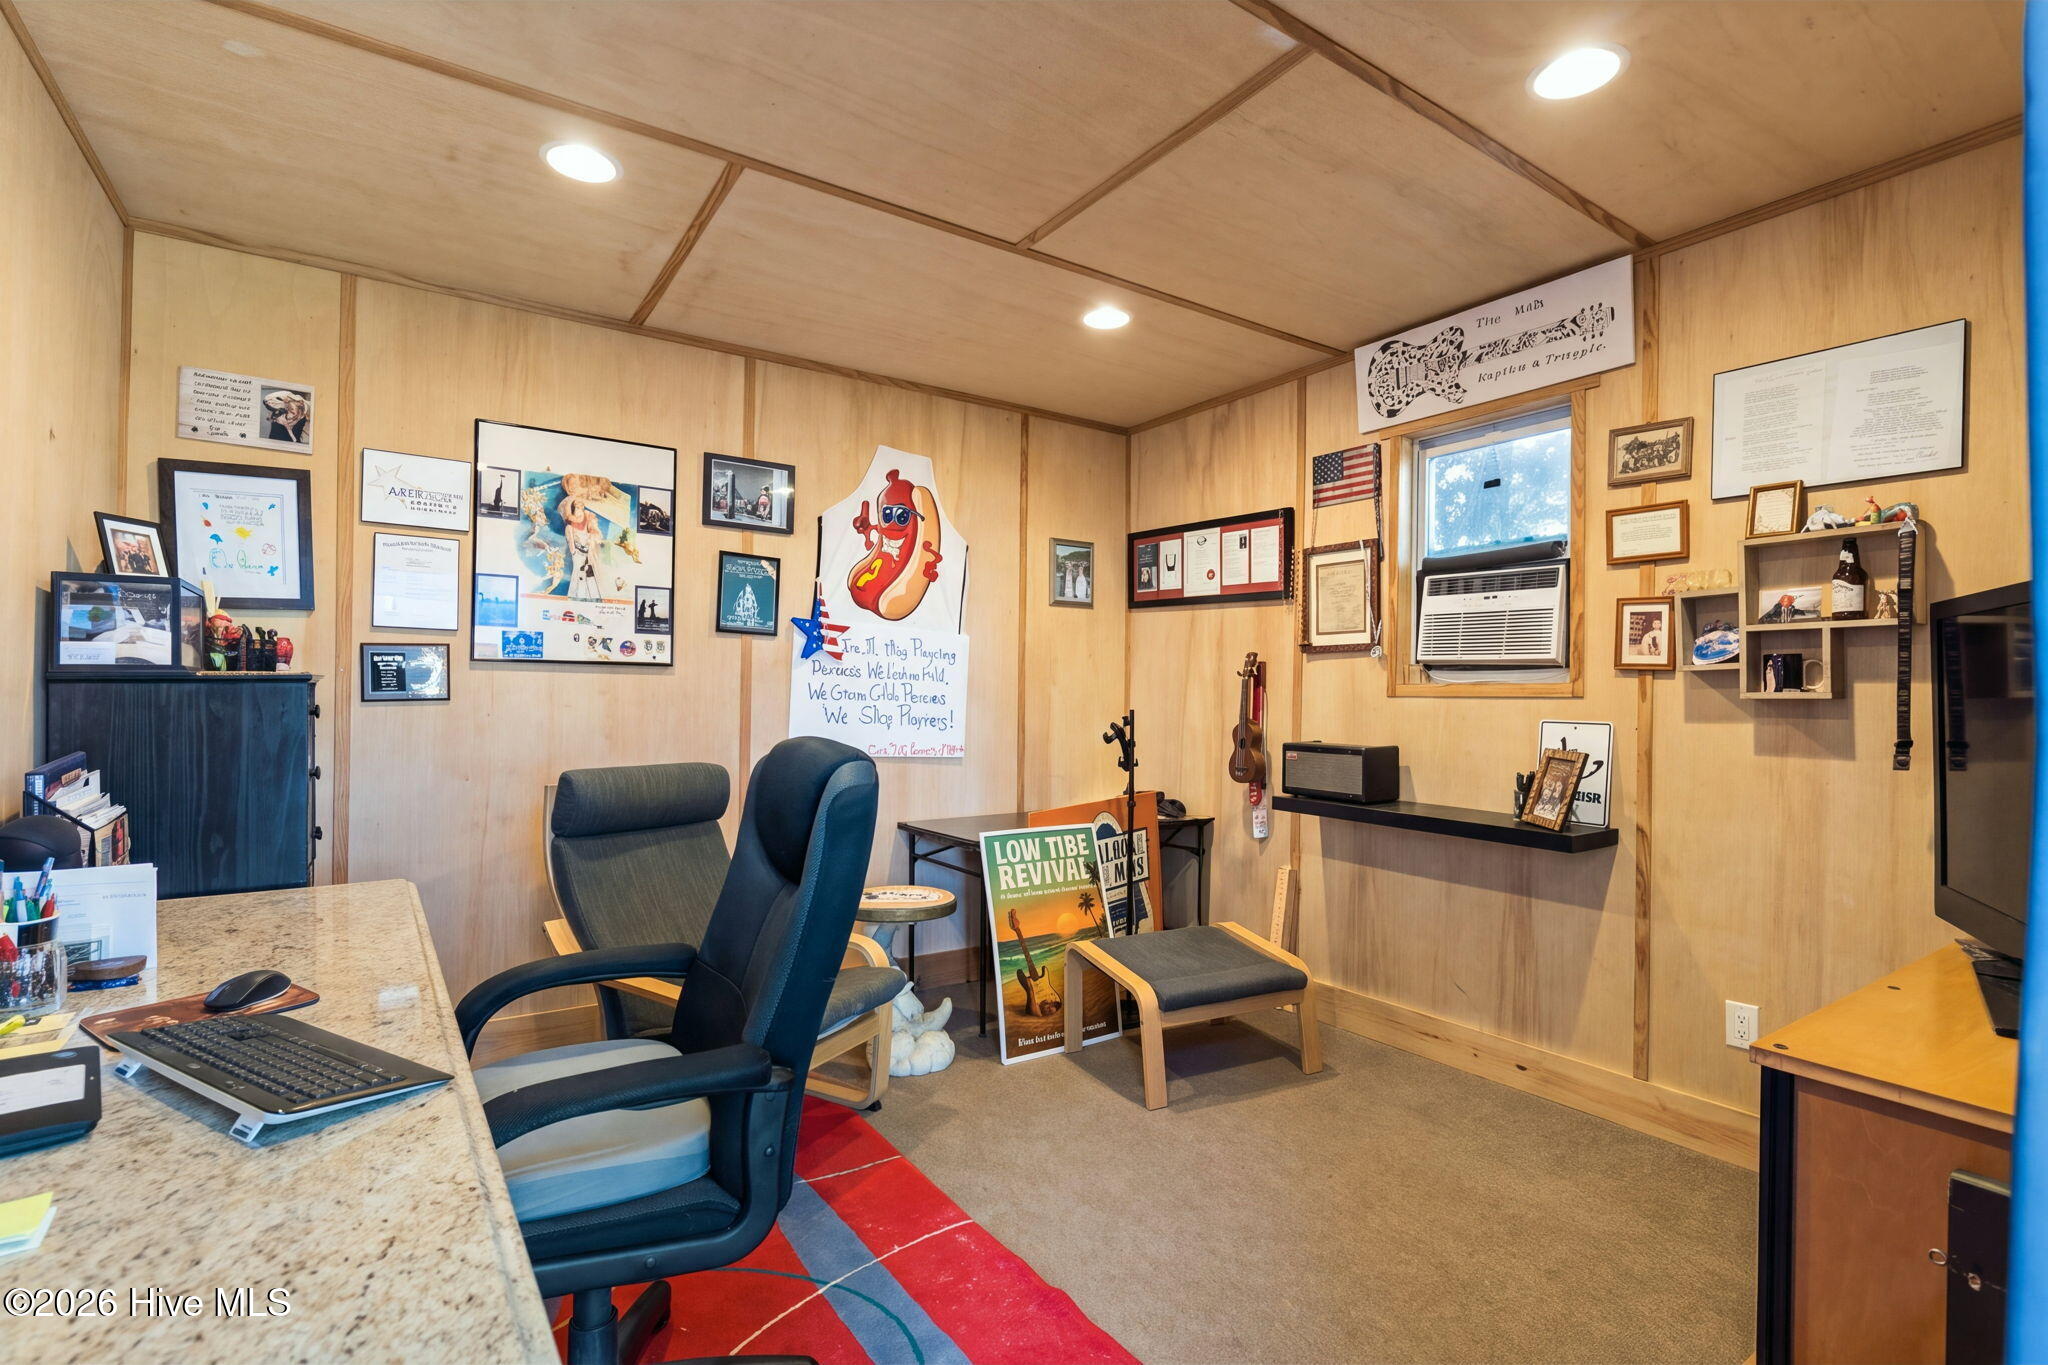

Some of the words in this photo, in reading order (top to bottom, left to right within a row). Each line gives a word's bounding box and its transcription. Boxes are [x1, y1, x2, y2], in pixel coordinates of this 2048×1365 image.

[808, 682, 828, 701] We
[993, 837, 1041, 865] LOW
[1045, 833, 1089, 859] TIBE
[997, 856, 1091, 891] REVIVAL
